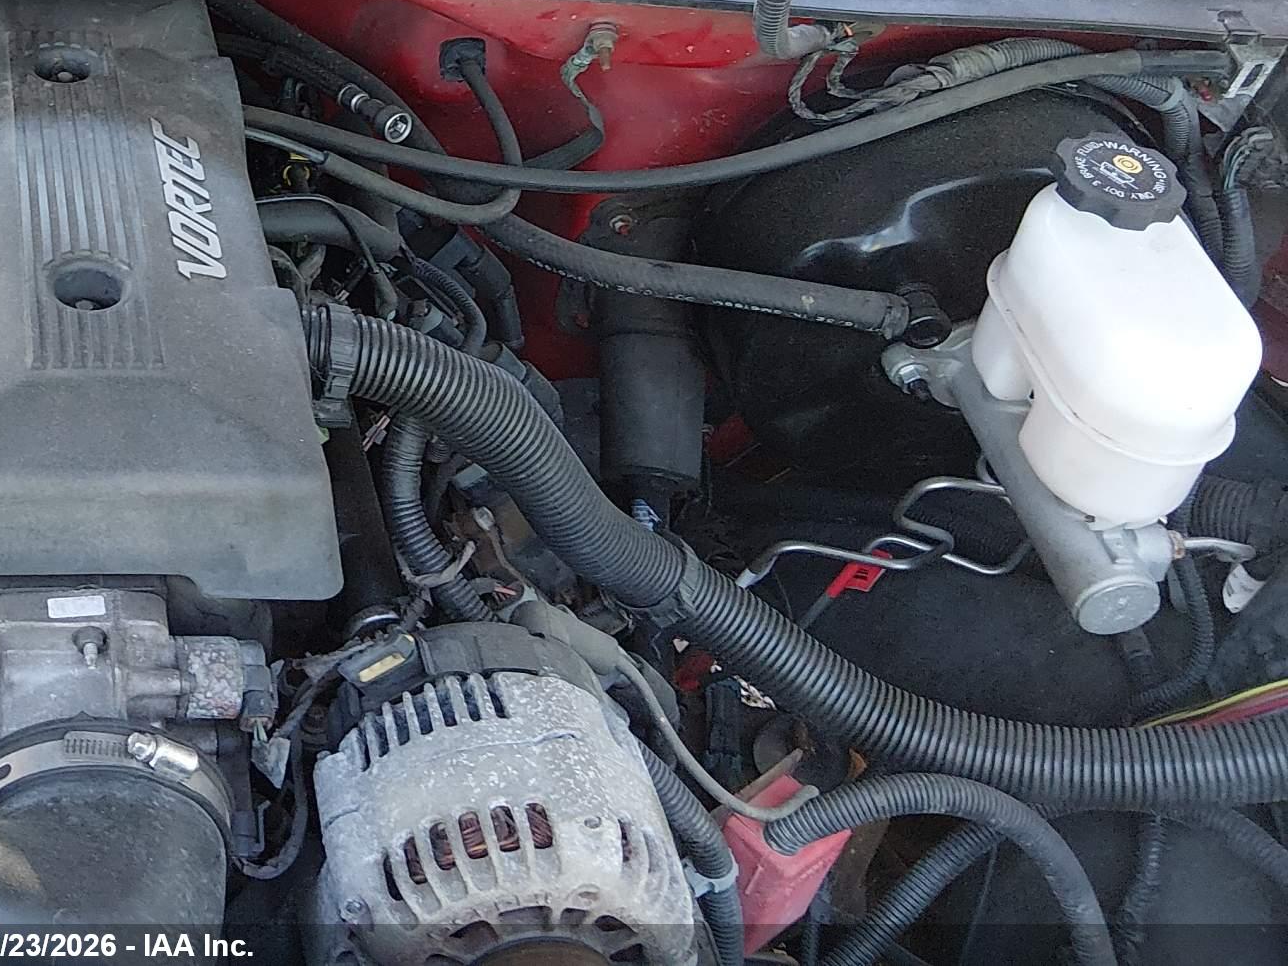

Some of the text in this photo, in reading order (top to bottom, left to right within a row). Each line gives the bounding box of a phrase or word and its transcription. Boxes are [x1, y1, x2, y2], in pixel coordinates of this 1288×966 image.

[1076, 141, 1101, 157] FLUID
[1074, 156, 1095, 179] BRAKE
[1103, 140, 1167, 179] WARNING
[150, 117, 227, 279] VORTEC
[1103, 186, 1125, 198] DOT
[1130, 191, 1156, 200] ONLY
